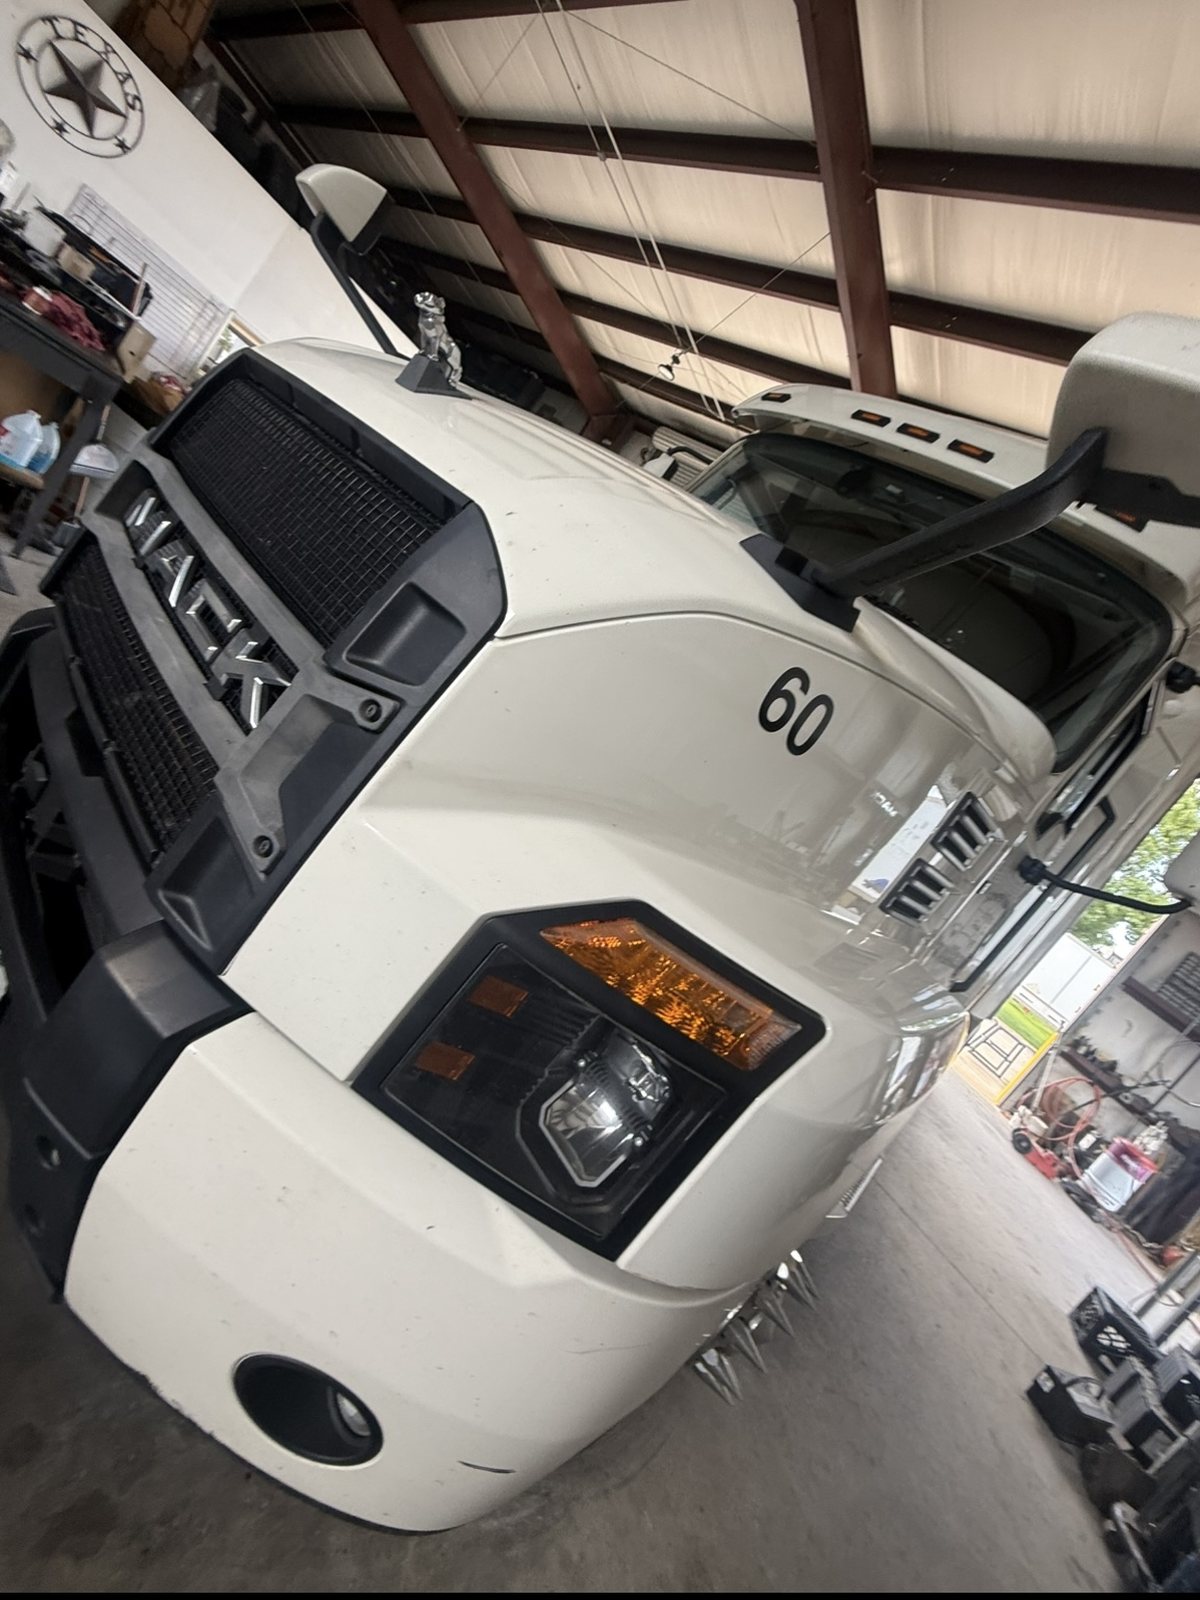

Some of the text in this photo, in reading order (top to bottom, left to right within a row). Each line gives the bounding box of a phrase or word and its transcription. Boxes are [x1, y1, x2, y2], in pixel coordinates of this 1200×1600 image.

[40, 15, 144, 113] TEXAS
[124, 488, 292, 729] MACK
[758, 666, 835, 756] 60
